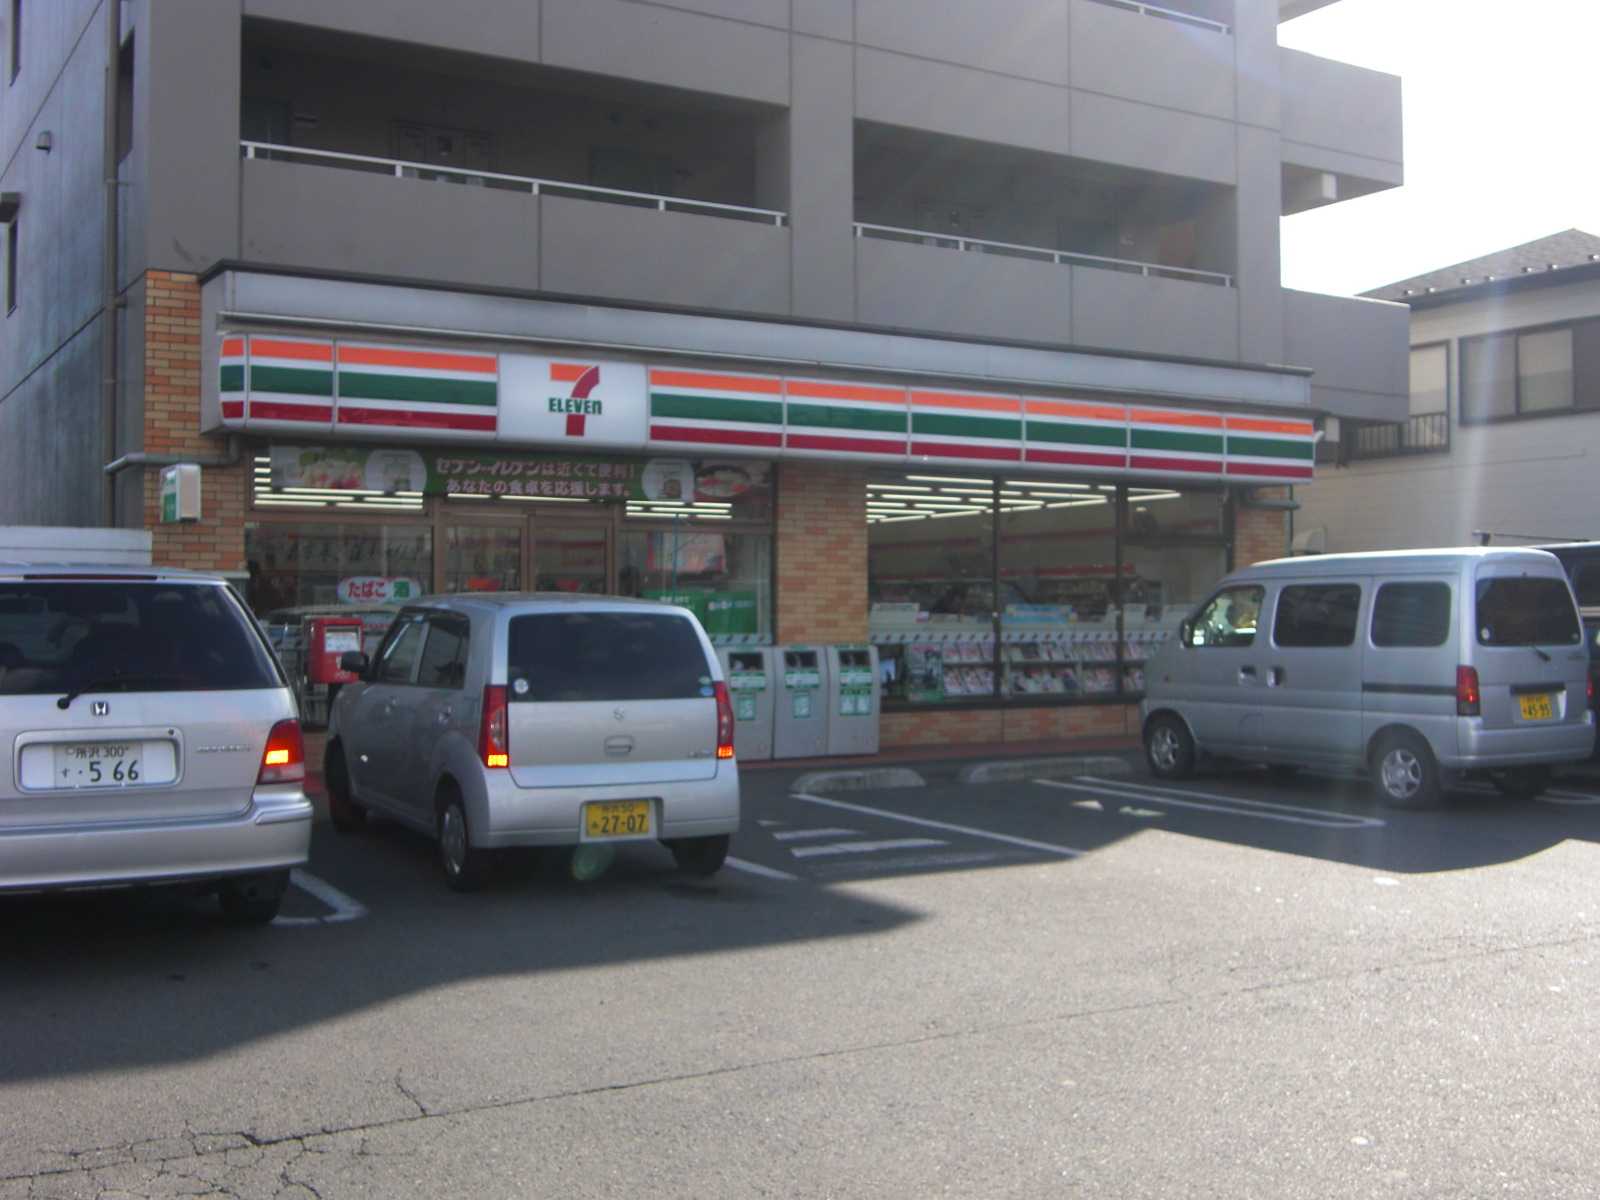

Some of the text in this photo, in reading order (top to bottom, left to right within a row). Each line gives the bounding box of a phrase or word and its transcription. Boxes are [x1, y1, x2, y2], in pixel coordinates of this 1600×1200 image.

[549, 362, 600, 436] 7
[347, 580, 386, 598] たばこ
[601, 813, 647, 833] 27-07
